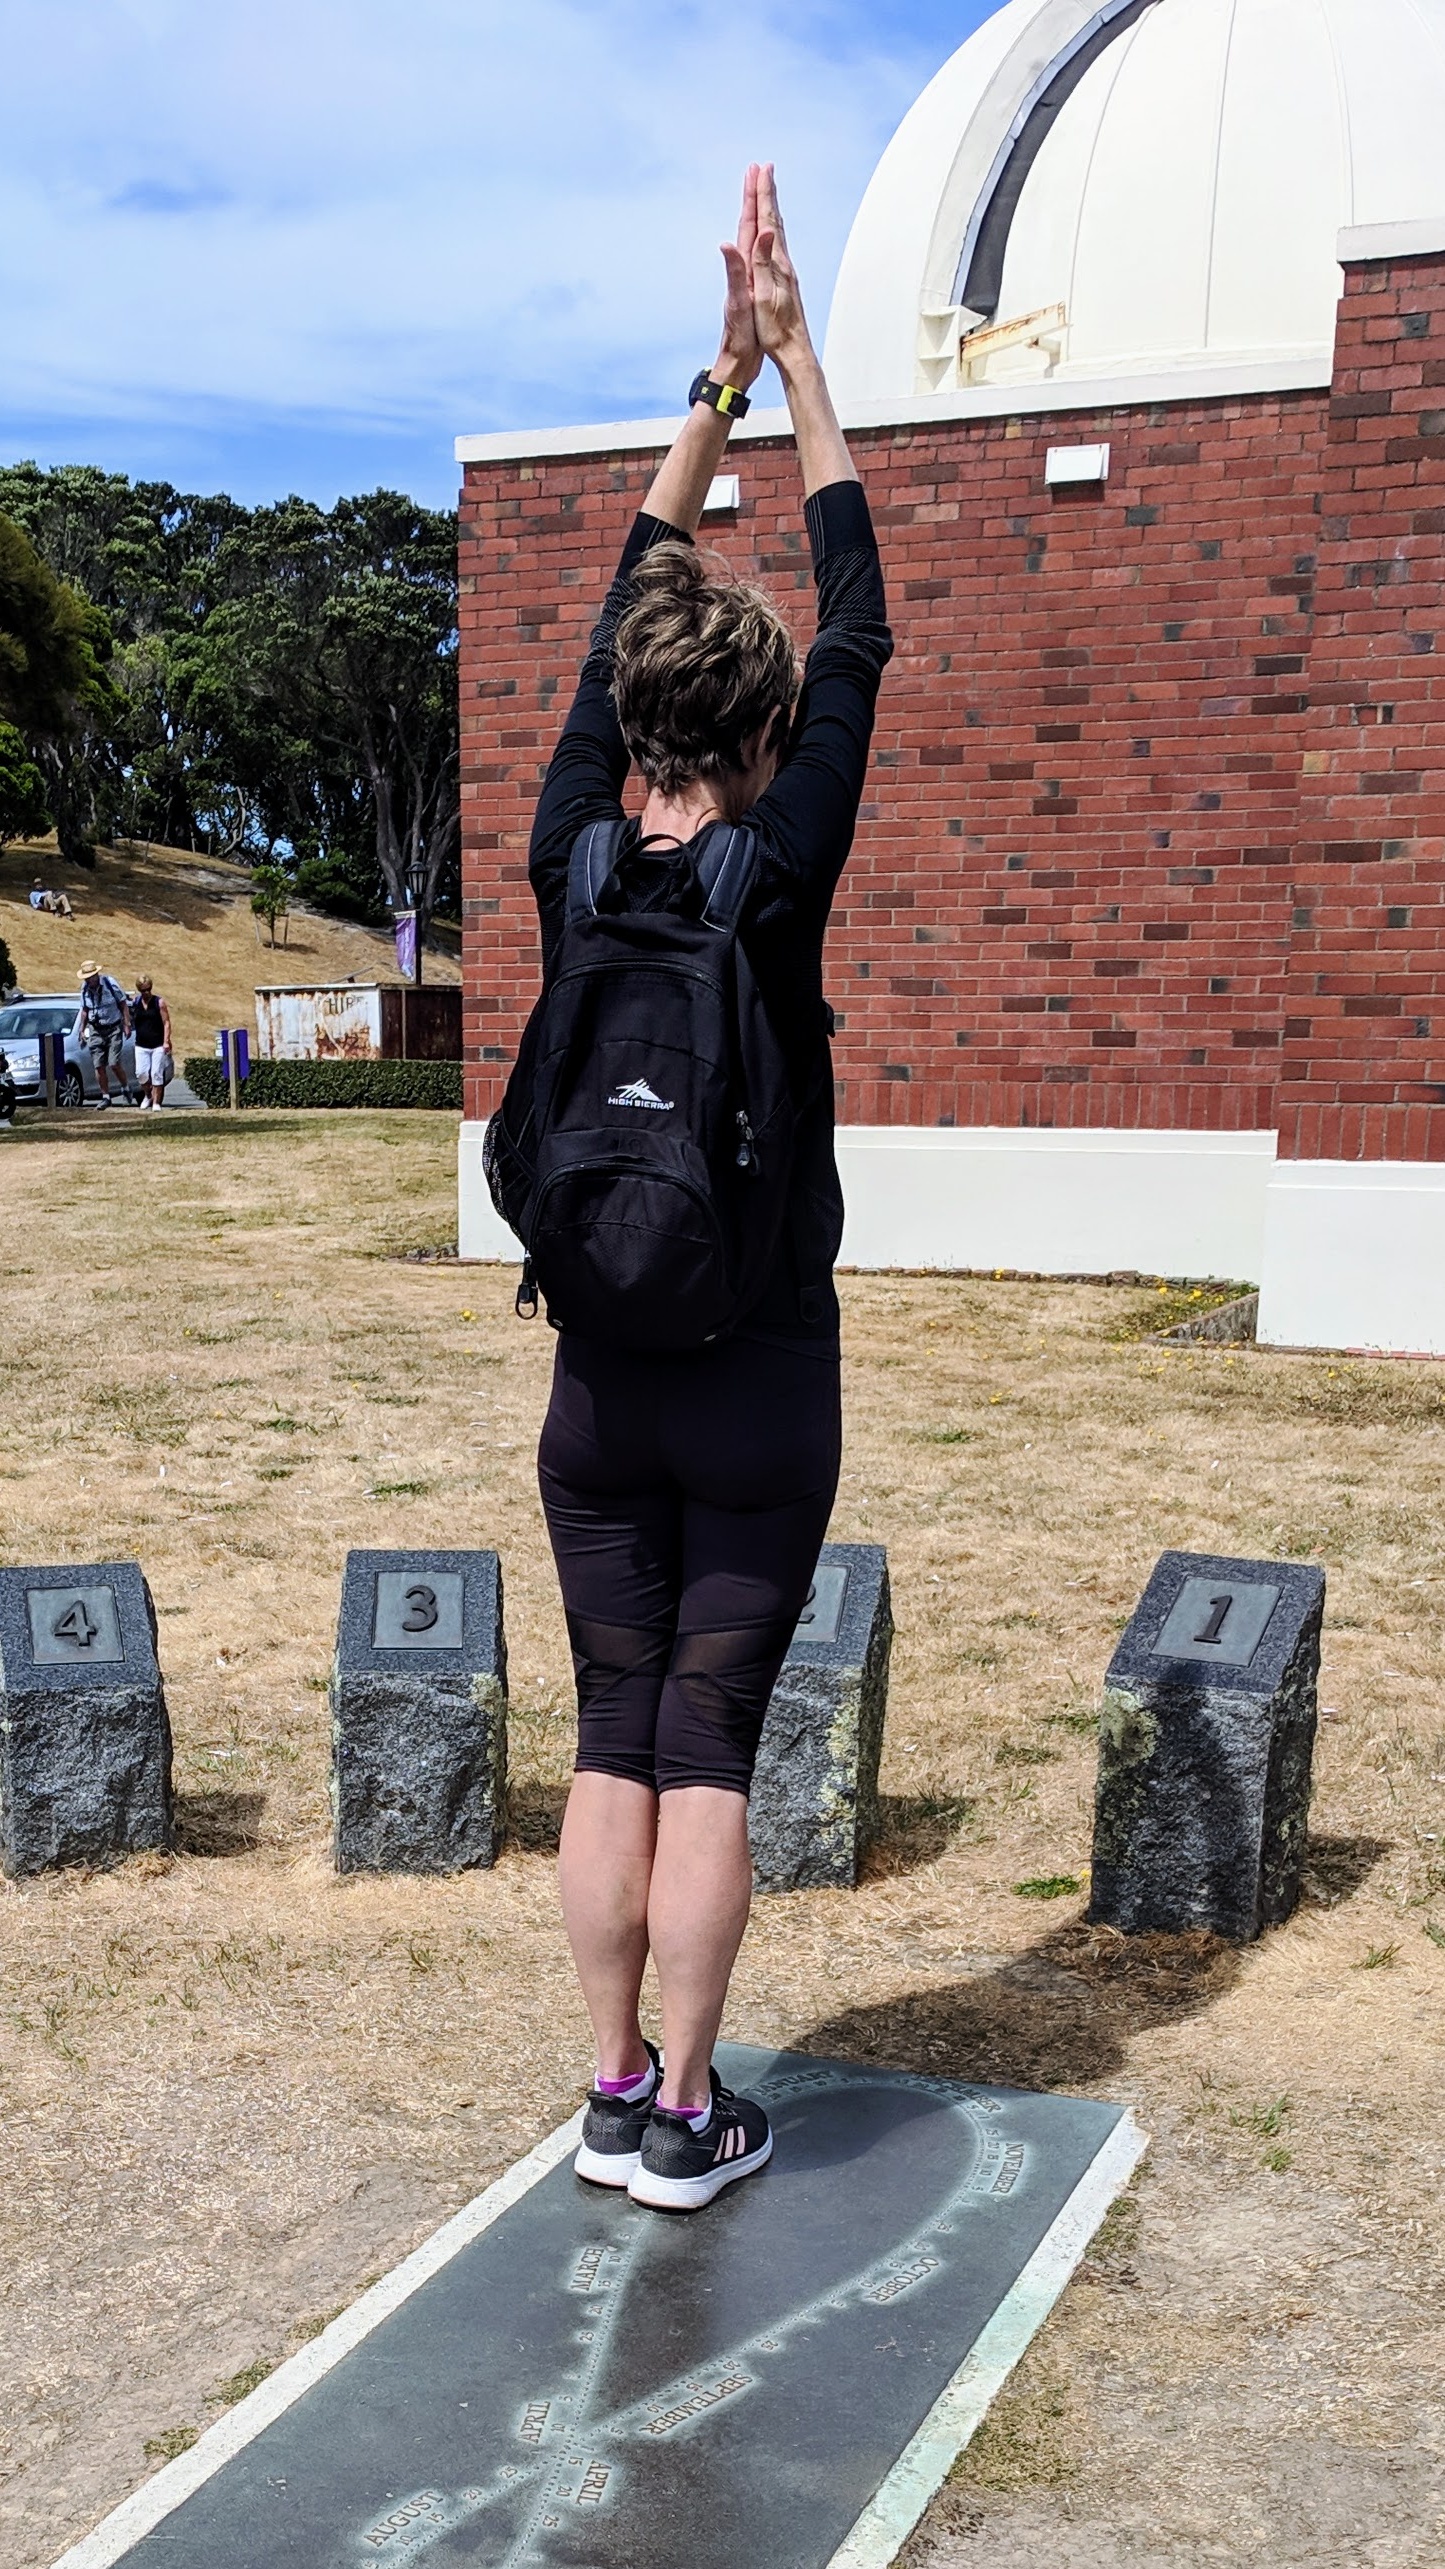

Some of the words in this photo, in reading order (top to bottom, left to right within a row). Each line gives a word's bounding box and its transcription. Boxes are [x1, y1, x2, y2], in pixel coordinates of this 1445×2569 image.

[608, 1097, 633, 1107] HIGH
[634, 1099, 670, 1111] SIERRA
[54, 1600, 98, 1648] 4
[402, 1585, 438, 1633] 3
[1193, 1594, 1233, 1645] 1
[988, 2142, 1025, 2195] NOVEMBER
[570, 2247, 606, 2292] MARCH
[863, 2256, 940, 2302] OCTOBER
[519, 2400, 552, 2445] APRIL
[638, 2372, 753, 2436] SEPTEMBER
[567, 2456, 585, 2467] 15
[574, 2459, 613, 2507] APRIL
[426, 2511, 446, 2524] 15
[462, 2488, 483, 2501] 20
[500, 2466, 519, 2479] 25
[555, 2485, 573, 2497] 20
[363, 2490, 445, 2548] AUGUST
[542, 2514, 560, 2528] 25
